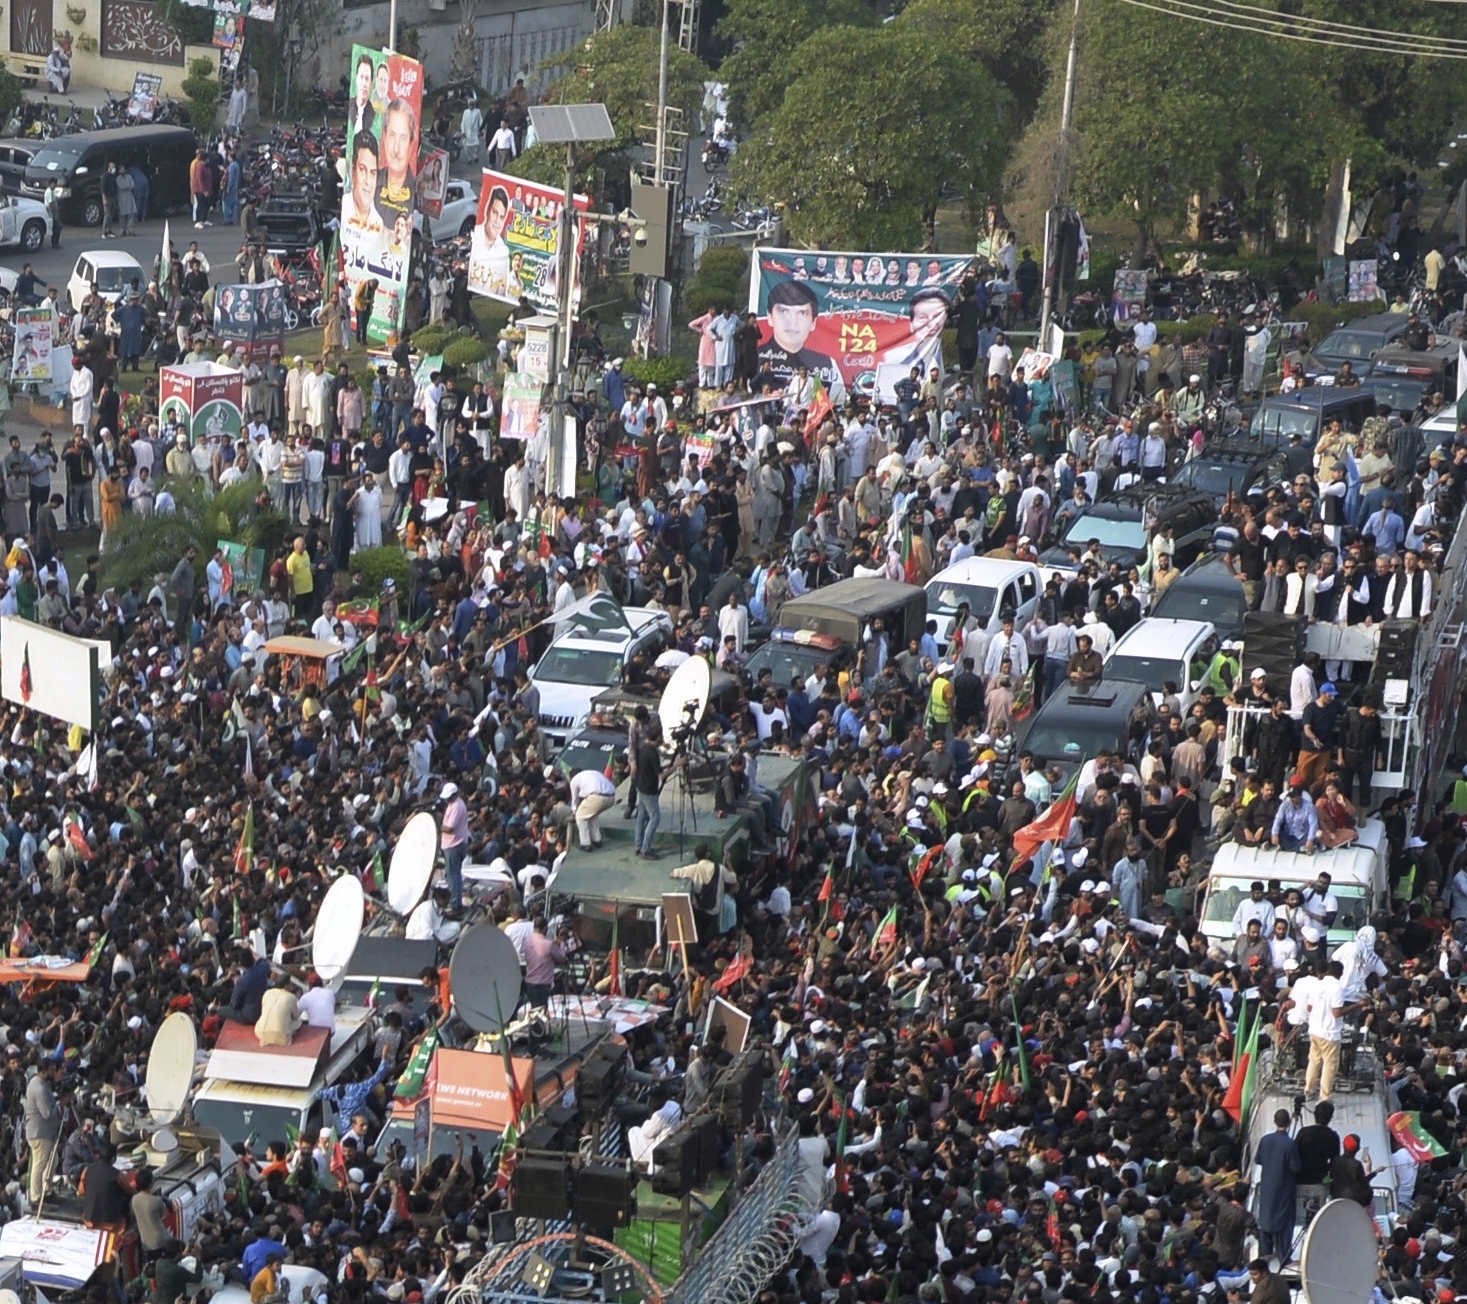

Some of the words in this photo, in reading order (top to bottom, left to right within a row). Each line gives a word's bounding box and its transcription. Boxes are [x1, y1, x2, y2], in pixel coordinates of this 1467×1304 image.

[535, 265, 548, 287] 28
[840, 323, 877, 339] NA
[838, 338, 878, 353] 124
[459, 1084, 508, 1101] NETWORK
